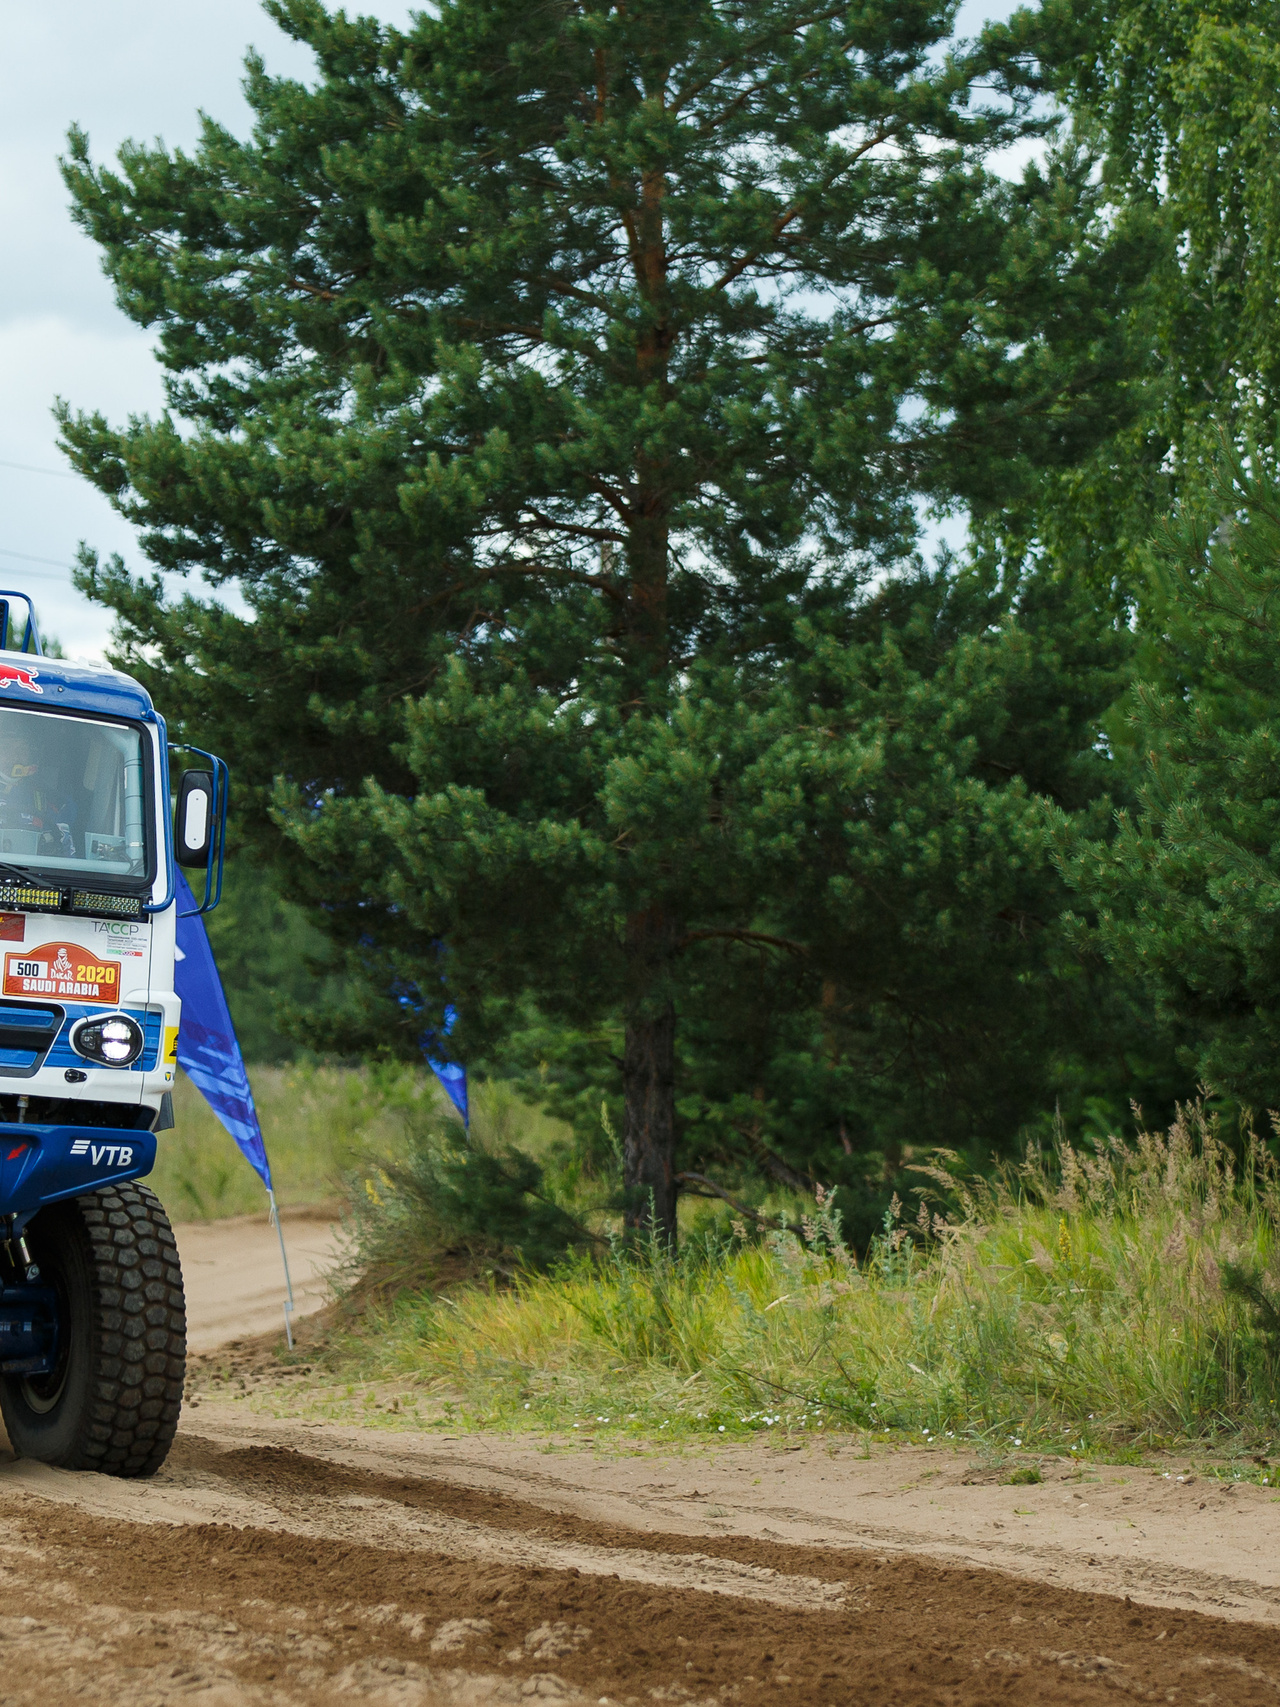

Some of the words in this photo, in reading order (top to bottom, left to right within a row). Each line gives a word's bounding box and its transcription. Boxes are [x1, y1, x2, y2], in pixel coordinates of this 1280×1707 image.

[17, 962, 39, 977] 500
[76, 965, 115, 984] 2020
[22, 978, 57, 993] SAUDI
[58, 981, 99, 996] ARABIA
[90, 1145, 134, 1167] VTB
